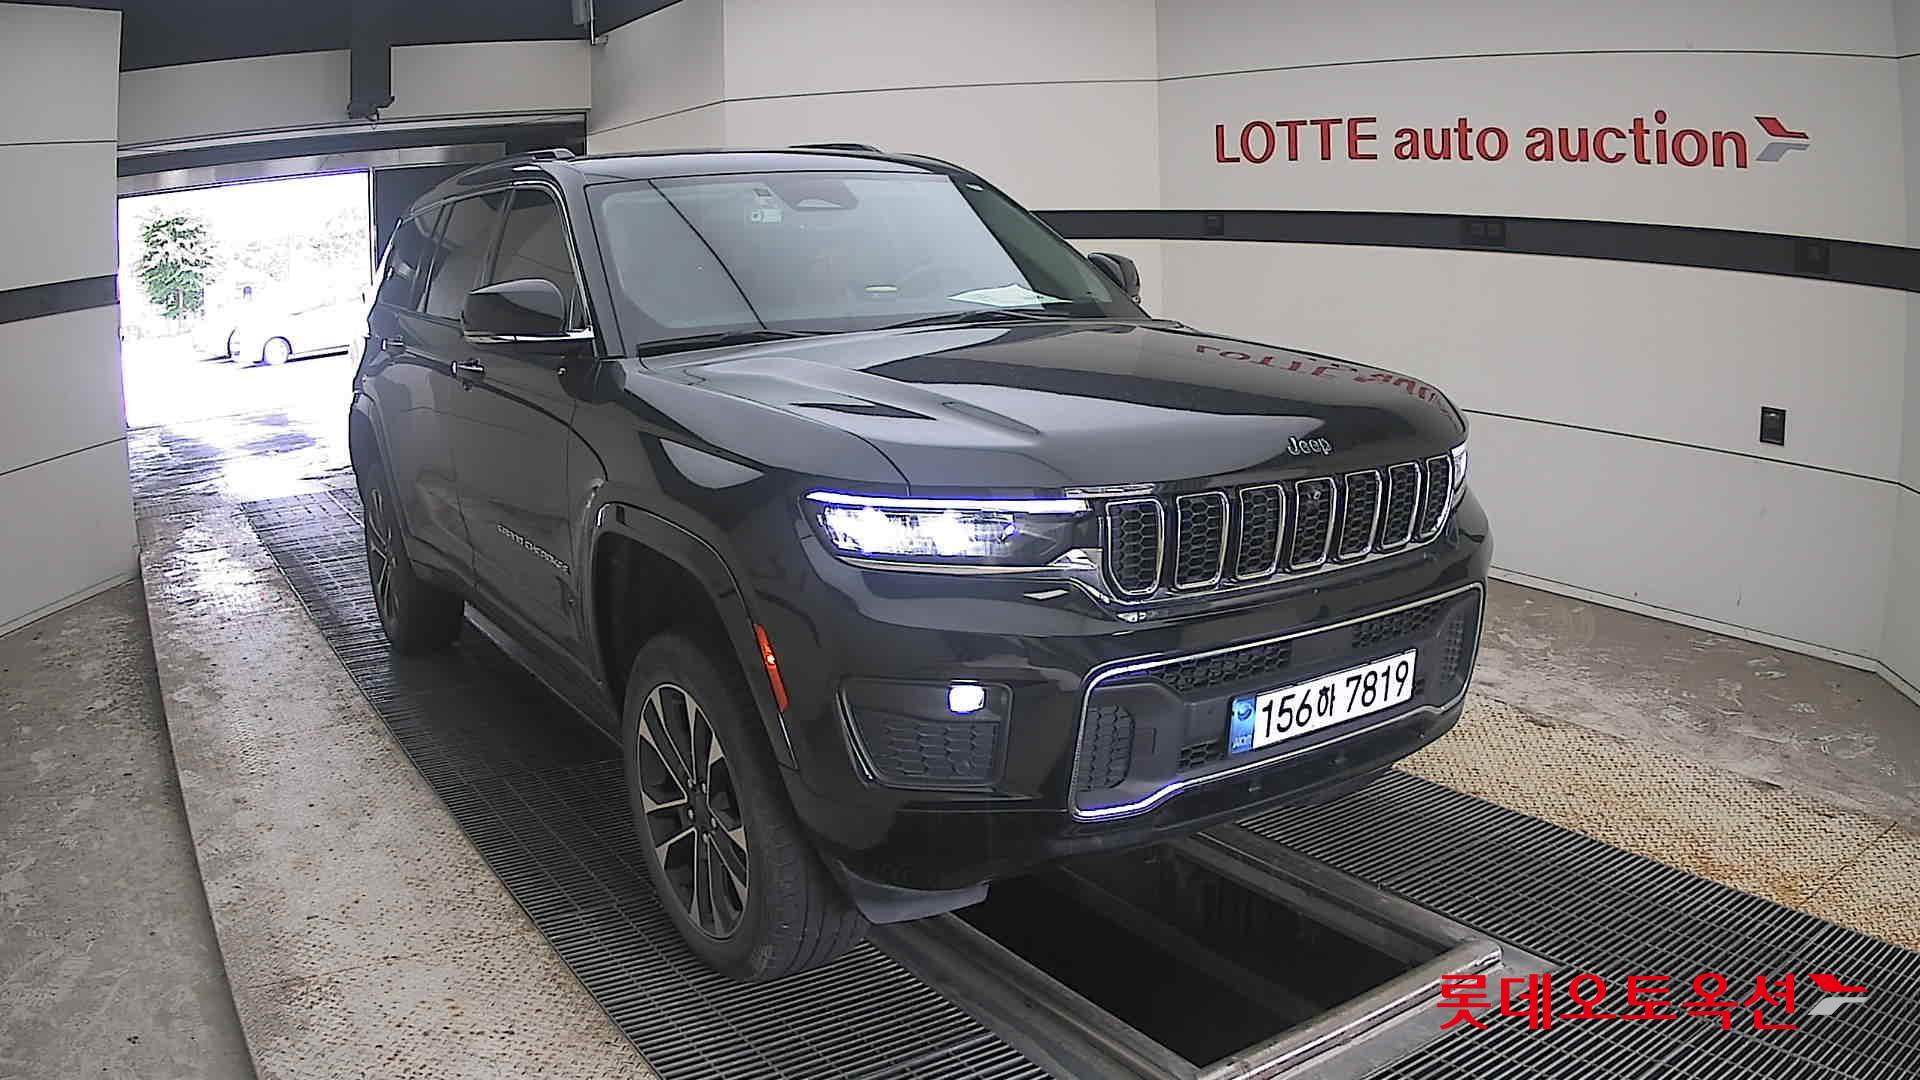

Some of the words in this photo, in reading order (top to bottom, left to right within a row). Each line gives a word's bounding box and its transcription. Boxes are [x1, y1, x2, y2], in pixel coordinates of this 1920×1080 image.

[1214, 116, 1379, 164] LOTTE
[1392, 117, 1509, 162] auto
[1524, 109, 1748, 169] auction
[1287, 436, 1333, 456] Jeep
[1262, 683, 1336, 738] 156하
[1345, 660, 1410, 713] 7819
